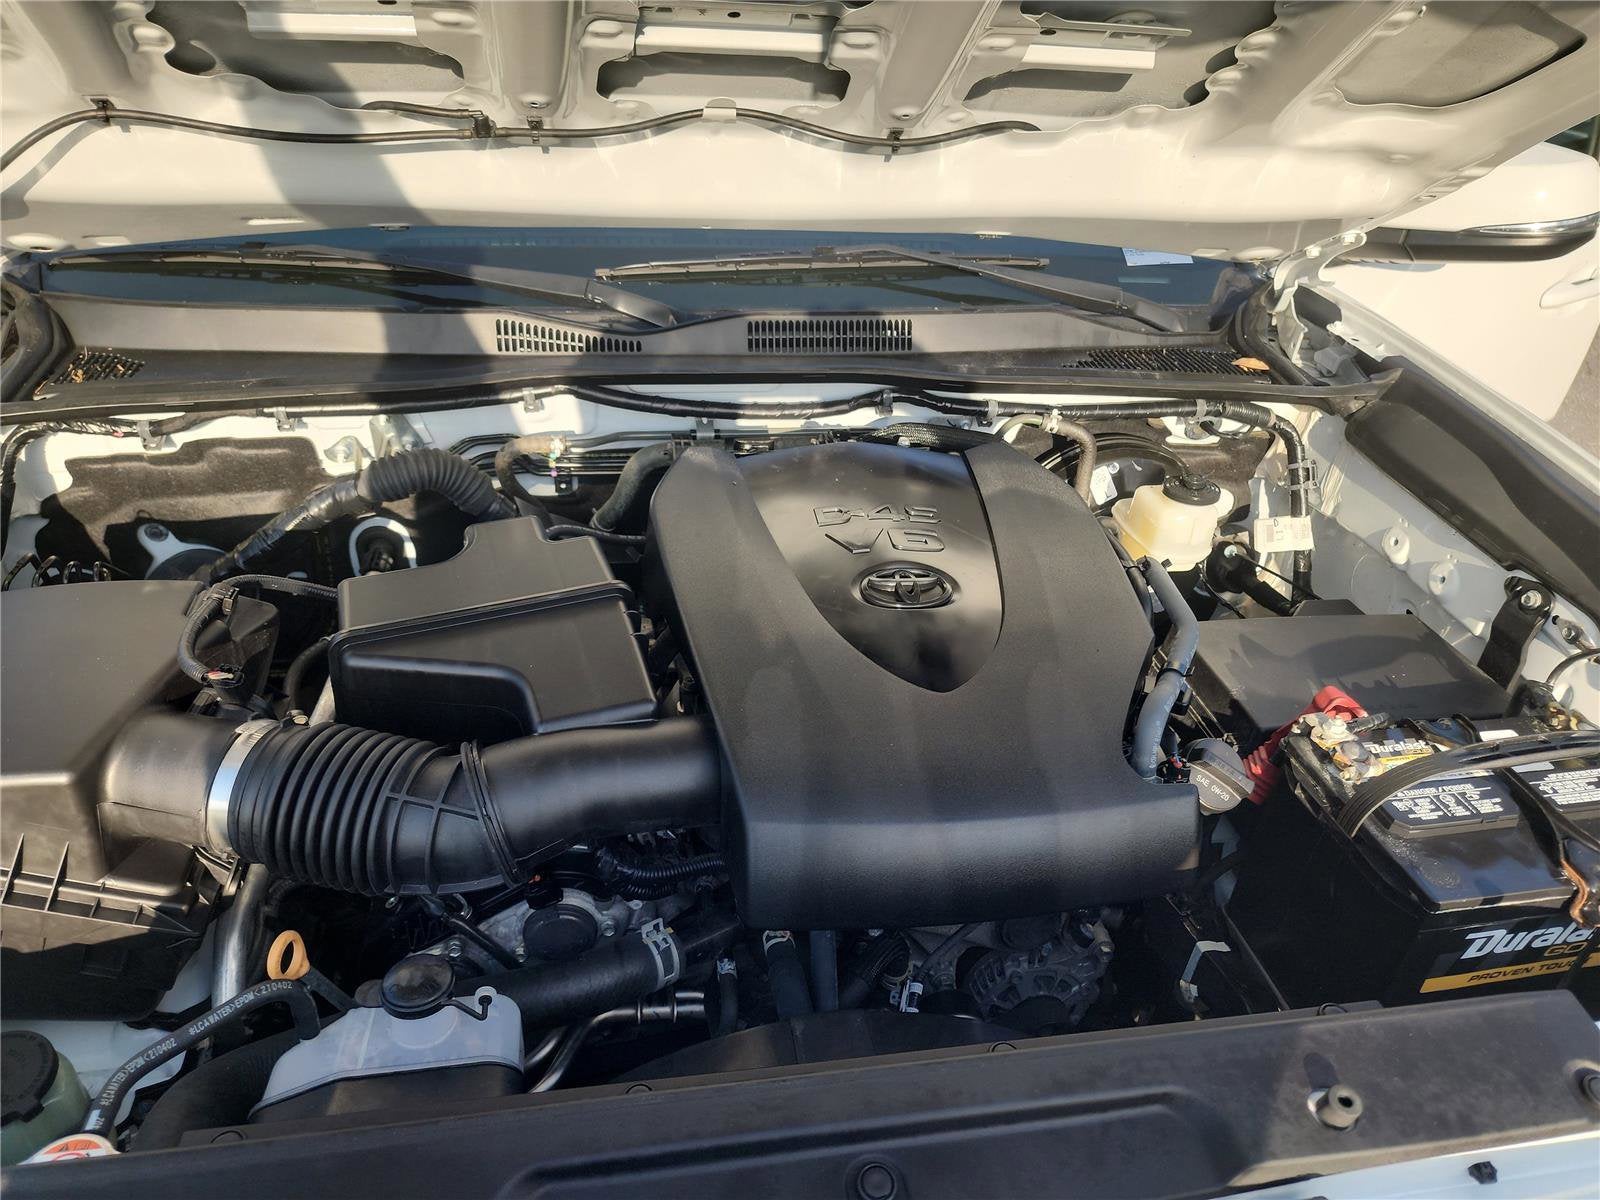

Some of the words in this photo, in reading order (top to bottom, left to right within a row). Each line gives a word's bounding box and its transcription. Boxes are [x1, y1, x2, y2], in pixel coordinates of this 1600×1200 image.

[813, 504, 942, 527] D-4S
[824, 527, 945, 554] V6
[1364, 740, 1427, 754] Duralast
[1196, 774, 1210, 787] SAE
[1210, 784, 1231, 802] 0W-20
[1460, 921, 1595, 960] Durala
[1467, 967, 1535, 983] PROVEN
[1538, 960, 1575, 972] TOU
